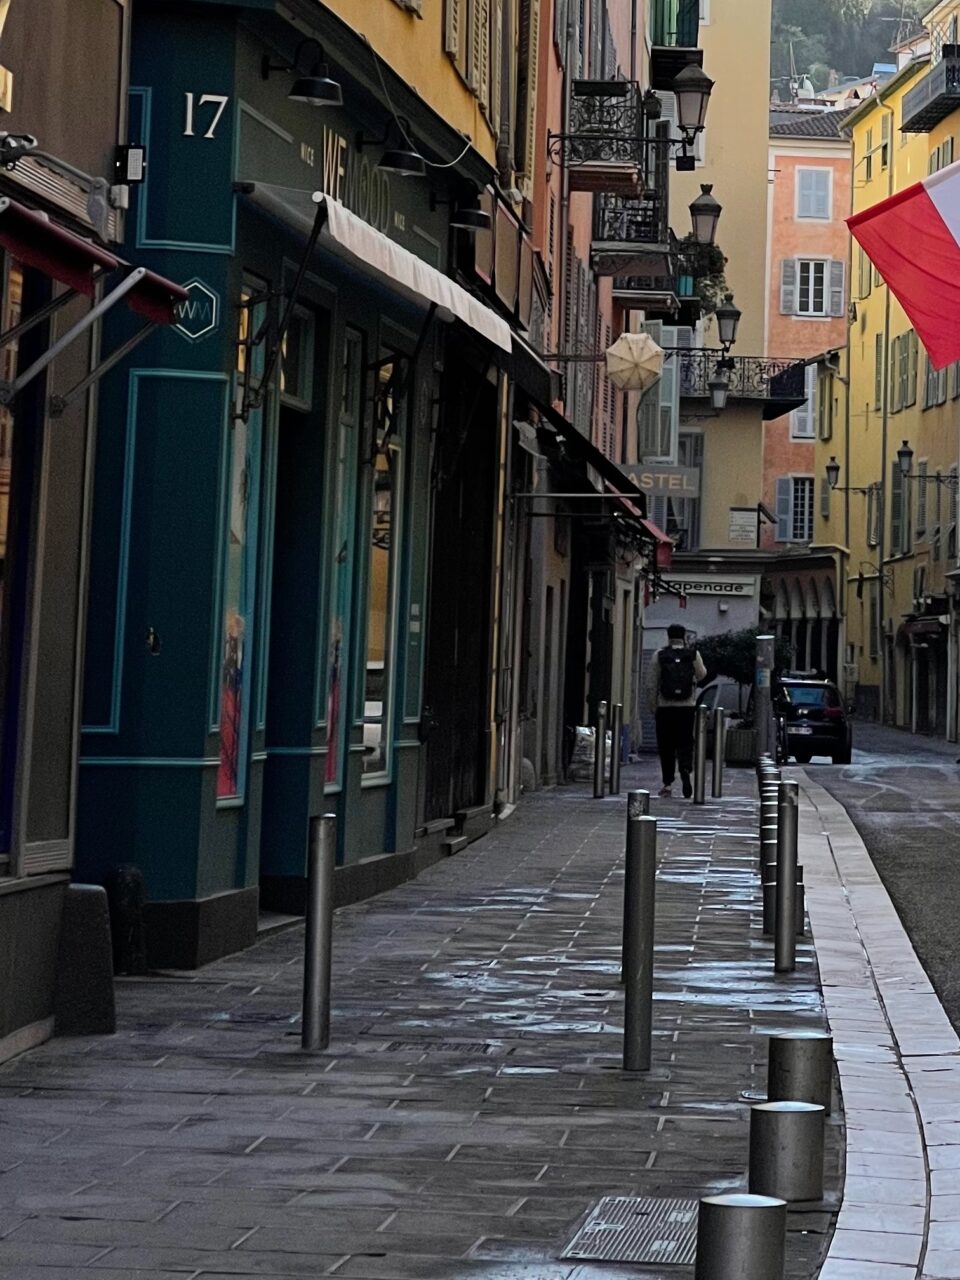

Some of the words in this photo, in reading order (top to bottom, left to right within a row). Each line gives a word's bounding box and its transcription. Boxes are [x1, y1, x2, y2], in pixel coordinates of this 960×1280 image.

[181, 91, 230, 140] 17
[177, 299, 211, 321] WM
[627, 472, 695, 490] ASTEL
